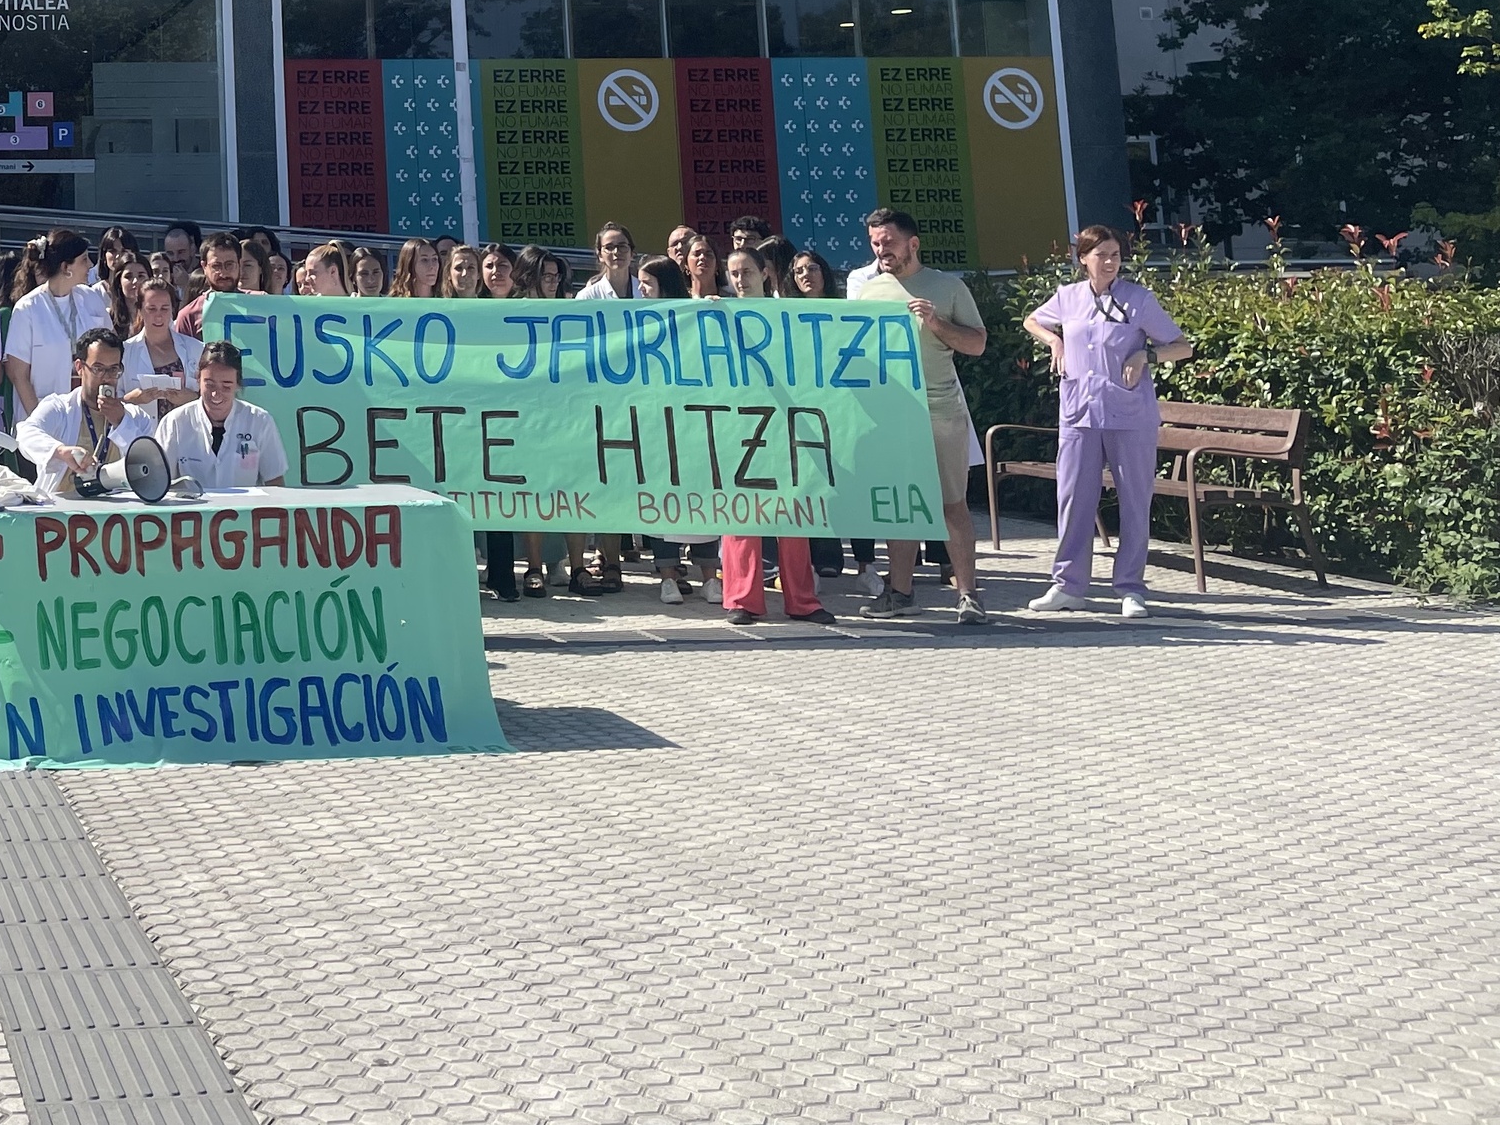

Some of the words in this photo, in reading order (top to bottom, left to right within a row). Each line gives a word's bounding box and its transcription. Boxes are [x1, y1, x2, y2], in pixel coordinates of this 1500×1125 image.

[297, 70, 319, 84] EZ
[323, 70, 370, 84] ERRE
[493, 70, 515, 83] EZ
[519, 69, 566, 83] ERRE
[688, 68, 710, 82] EZ
[713, 68, 760, 82] ERRE
[880, 68, 902, 81] EZ
[905, 67, 951, 81] ERRE
[298, 101, 320, 114] EZ
[324, 101, 371, 114] ERRE
[495, 100, 517, 113] EZ
[520, 100, 568, 113] ERRE
[690, 99, 712, 112] EZ
[715, 99, 762, 112] ERRE
[883, 98, 904, 111] EZ
[908, 97, 954, 111] ERRE
[299, 132, 322, 145] EZ
[325, 132, 373, 145] ERRE
[496, 130, 518, 144] EZ
[522, 130, 569, 144] ERRE
[692, 129, 713, 143] EZ
[717, 129, 764, 143] ERRE
[885, 128, 907, 142] EZ
[910, 128, 956, 141] ERRE
[301, 162, 323, 176] EZ
[326, 162, 374, 176] ERRE
[498, 161, 520, 175] EZ
[524, 161, 571, 175] ERRE
[694, 160, 716, 173] EZ
[719, 159, 766, 173] ERRE
[887, 159, 909, 172] EZ
[912, 158, 959, 172] ERRE
[302, 193, 324, 207] EZ
[328, 193, 376, 207] ERRE
[500, 192, 522, 205] EZ
[525, 192, 573, 205] ERRE
[696, 190, 718, 204] EZ
[721, 190, 768, 204] ERRE
[890, 189, 912, 203] EZ
[915, 189, 962, 202] ERRE
[501, 223, 524, 236] EZ
[527, 223, 575, 236] ERRE
[698, 221, 720, 234] EZ
[918, 219, 964, 233] ERRE
[920, 250, 967, 264] ERRE
[224, 312, 456, 388] EUSKO
[497, 309, 922, 390] JAURLARITZA
[296, 406, 527, 486] BETE
[595, 405, 835, 490] HITZA
[446, 489, 597, 521] TITUTUAK
[637, 489, 829, 528] BORROKAN!
[871, 484, 933, 526] ELA
[34, 505, 402, 582] PROPAGANDA
[36, 575, 388, 671] NEGOCIACIÓN
[74, 662, 448, 754] INVESTIGACIÓN
